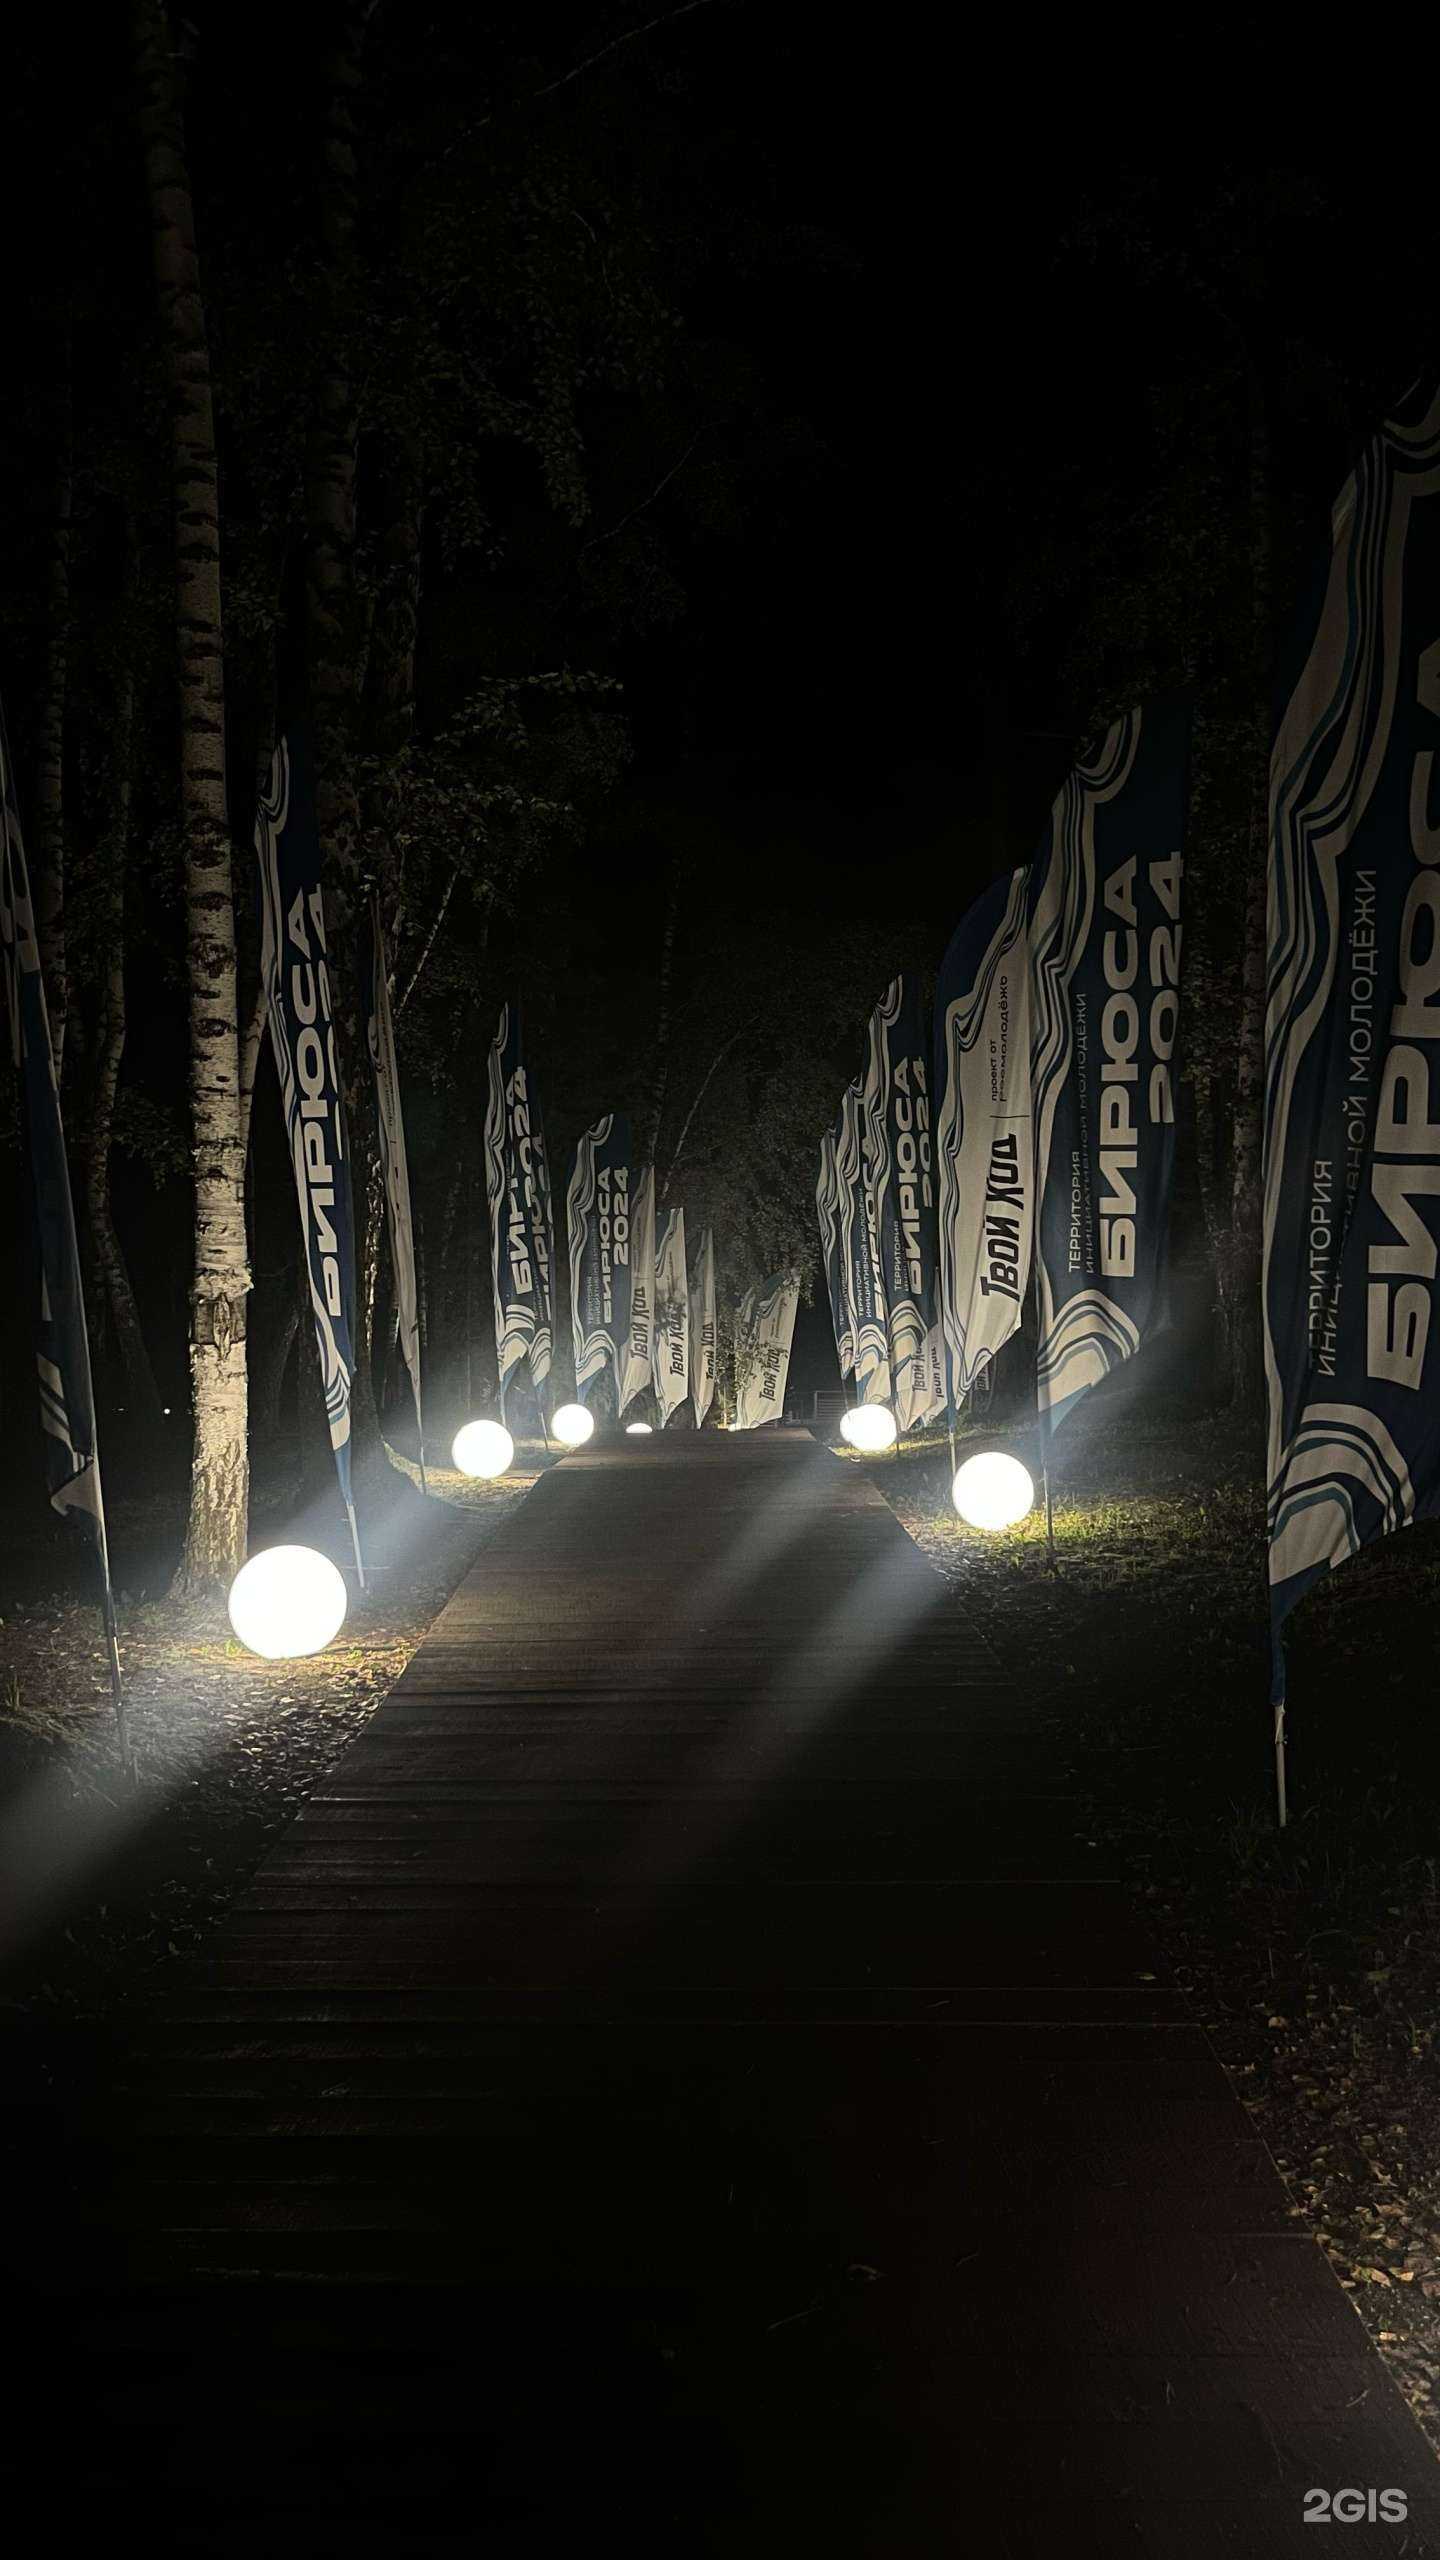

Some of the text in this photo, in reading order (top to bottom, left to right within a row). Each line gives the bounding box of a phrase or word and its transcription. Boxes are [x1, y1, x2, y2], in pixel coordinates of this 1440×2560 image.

[1099, 854, 1140, 1278] БИРЮСА
[1149, 850, 1184, 1124] 2024
[1348, 869, 1380, 1083] МОЛОДЁЖИ
[287, 884, 342, 1317] БИРЮСА
[893, 1055, 924, 1296] БИРЮСА
[1068, 1151, 1082, 1273] ТЕРРИТОРИЯ
[597, 1166, 613, 1324] БИРЮСА
[613, 1166, 629, 1266] 2024
